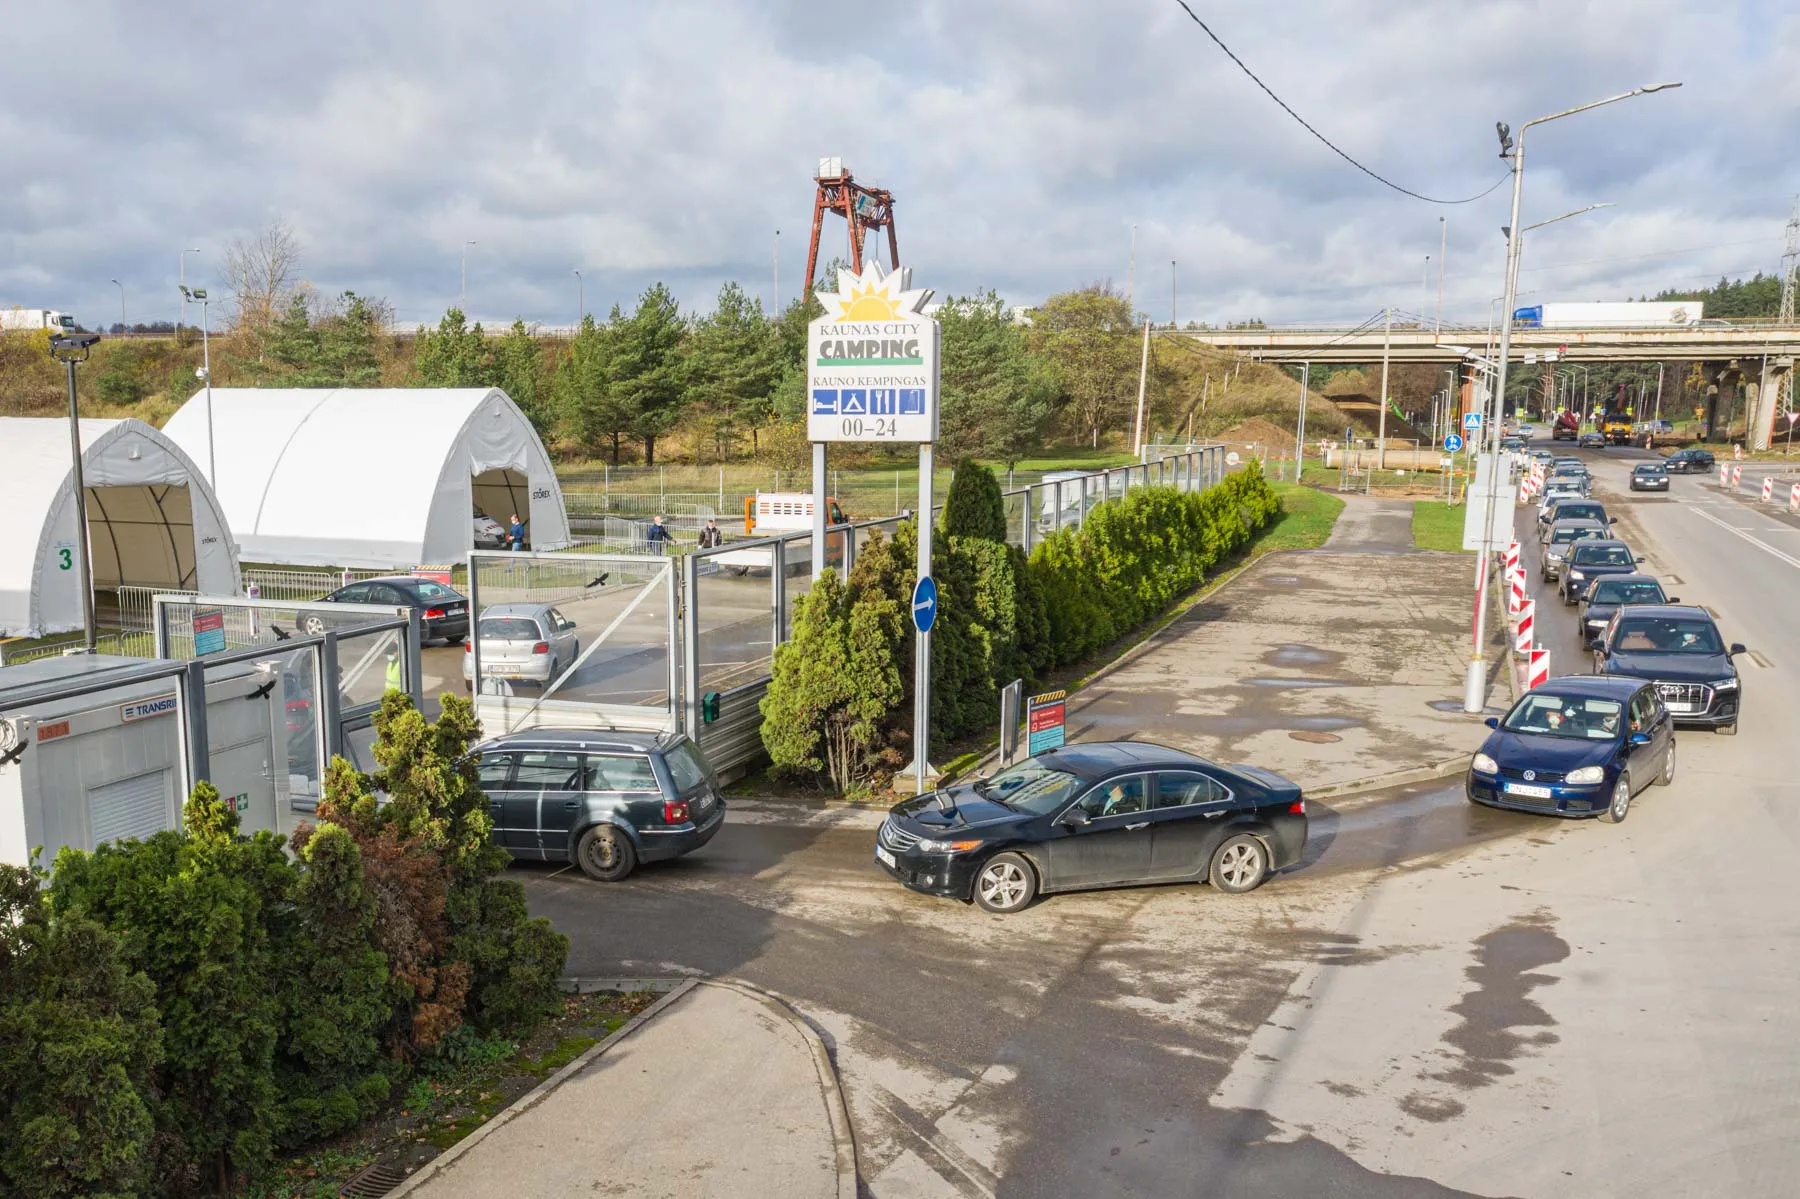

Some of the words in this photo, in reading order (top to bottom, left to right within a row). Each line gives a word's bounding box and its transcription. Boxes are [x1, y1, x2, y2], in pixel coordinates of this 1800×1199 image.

[820, 324, 879, 336] KAUNAS
[884, 324, 920, 335] CITY
[819, 339, 920, 359] CAMPING
[813, 377, 855, 386] KAUNO
[857, 376, 926, 386] KEMPINGAS
[58, 548, 73, 571] 3
